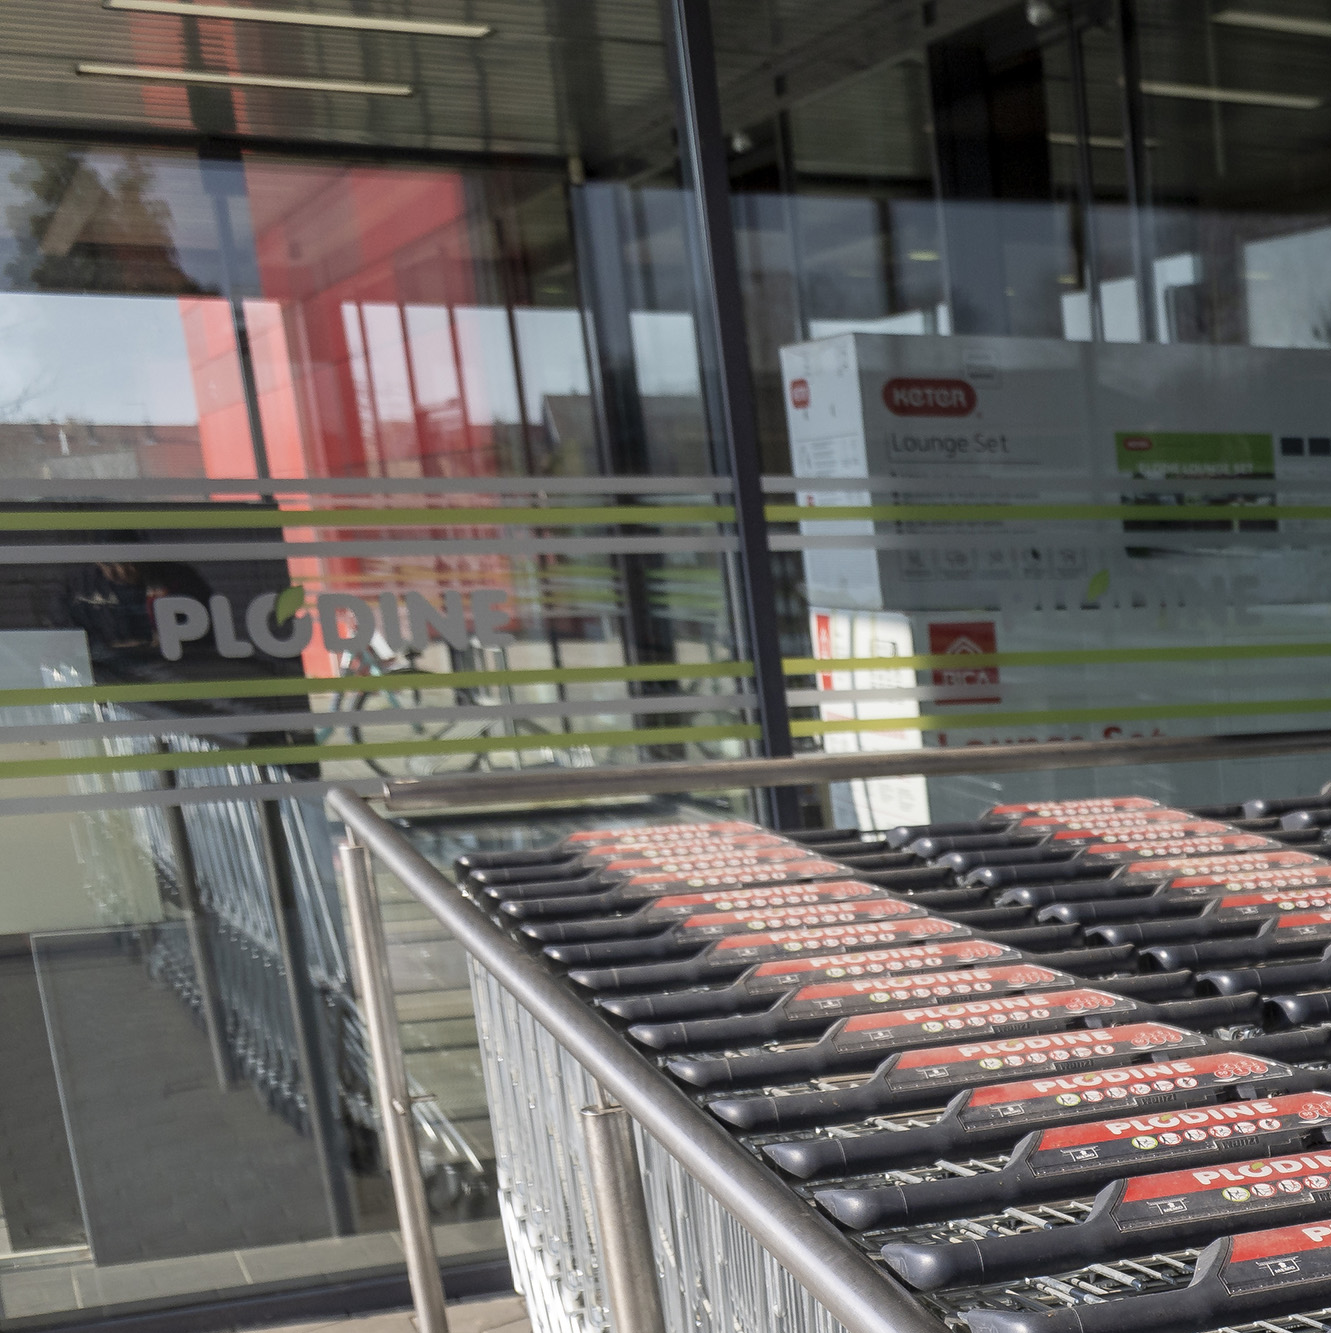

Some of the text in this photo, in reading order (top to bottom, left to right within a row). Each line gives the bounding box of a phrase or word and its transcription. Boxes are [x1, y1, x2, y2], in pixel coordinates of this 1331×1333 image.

[891, 433, 1010, 458] Lounge Set
[154, 588, 516, 662] PLODINE
[810, 946, 946, 967] PLODINE
[852, 970, 993, 991] PLODINE
[904, 997, 1049, 1021] PLODINE
[958, 1031, 1113, 1057] PLODINE
[1033, 1063, 1195, 1092] PLODINE
[1105, 1102, 1278, 1135] PLODINE
